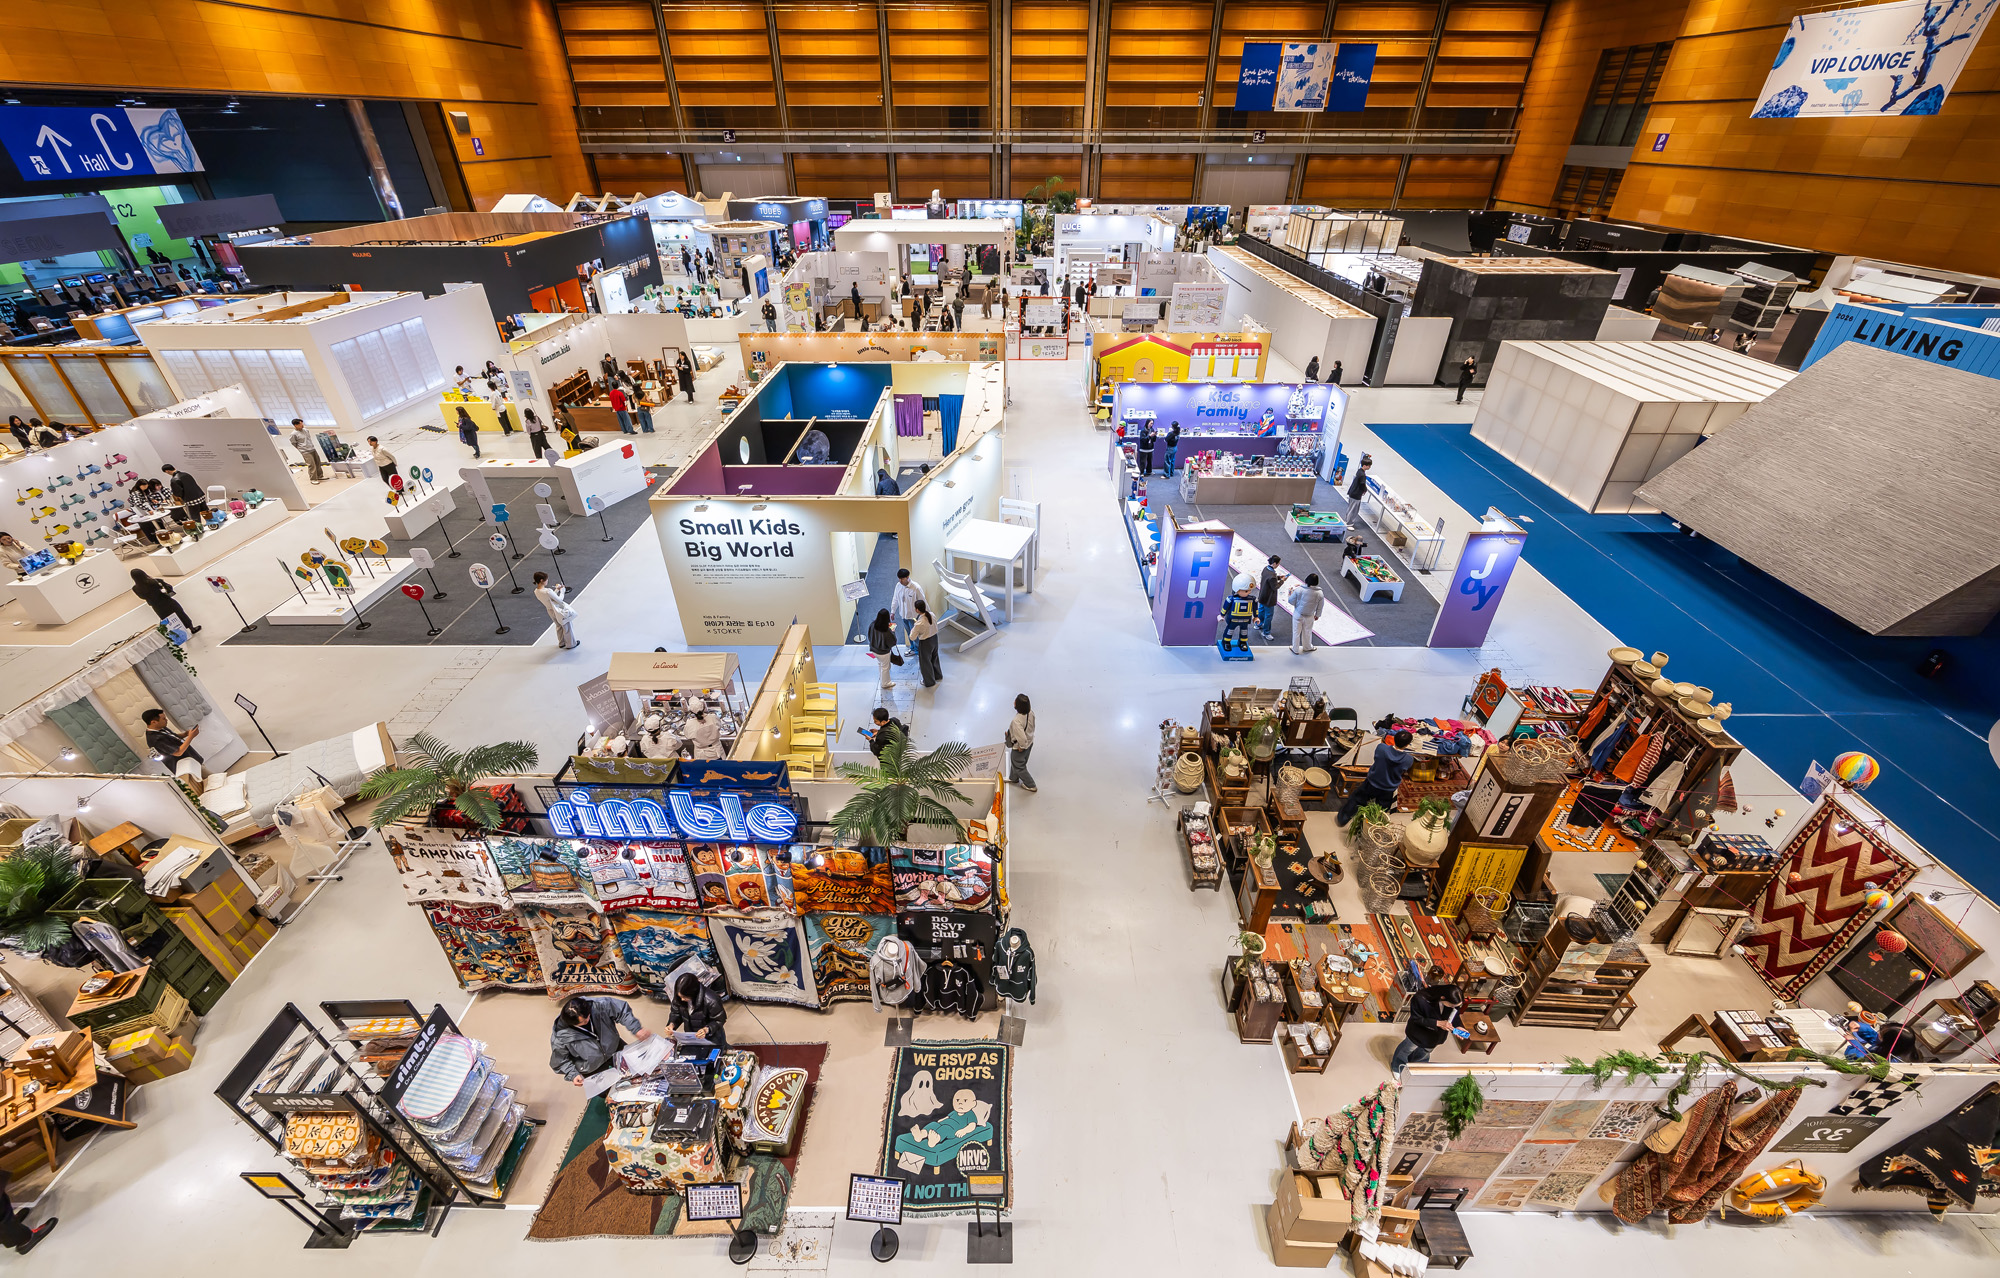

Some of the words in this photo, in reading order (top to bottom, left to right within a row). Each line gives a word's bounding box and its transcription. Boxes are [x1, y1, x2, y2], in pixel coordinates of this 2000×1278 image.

[1810, 56, 1839, 75] VIP
[1838, 50, 1916, 73] LOUNGE
[90, 113, 134, 171] C
[79, 153, 110, 172] Hall
[117, 203, 137, 218] C2
[1, 232, 65, 256] SEOUL
[1853, 318, 1963, 362] LIVING
[1208, 391, 1240, 402] Kids
[184, 404, 201, 414] ROOM
[1197, 405, 1248, 420] Family
[679, 518, 742, 536] Small
[749, 518, 805, 537] Kids,
[684, 541, 723, 561] Big
[727, 540, 794, 558] World
[1184, 551, 1213, 619] Fun
[1460, 553, 1500, 611] Joy
[548, 787, 798, 842] rimble
[408, 847, 477, 861] CAMPING
[807, 880, 883, 896] Adventure
[610, 897, 645, 909] FIRST
[818, 891, 872, 905] Awaits
[828, 915, 857, 932] go
[833, 924, 866, 937] out
[931, 923, 966, 931] RSVP
[931, 930, 959, 938] club
[820, 984, 850, 1003] ESCAPE
[913, 1053, 937, 1067] WE
[939, 1052, 977, 1067] RSVP
[979, 1052, 999, 1065] AS
[935, 1066, 994, 1081] GHOSTS.
[758, 1073, 792, 1124] BATHROOM
[959, 1149, 988, 1167] NRVC
[914, 1184, 944, 1199] NOT
[949, 1182, 968, 1197] TH
